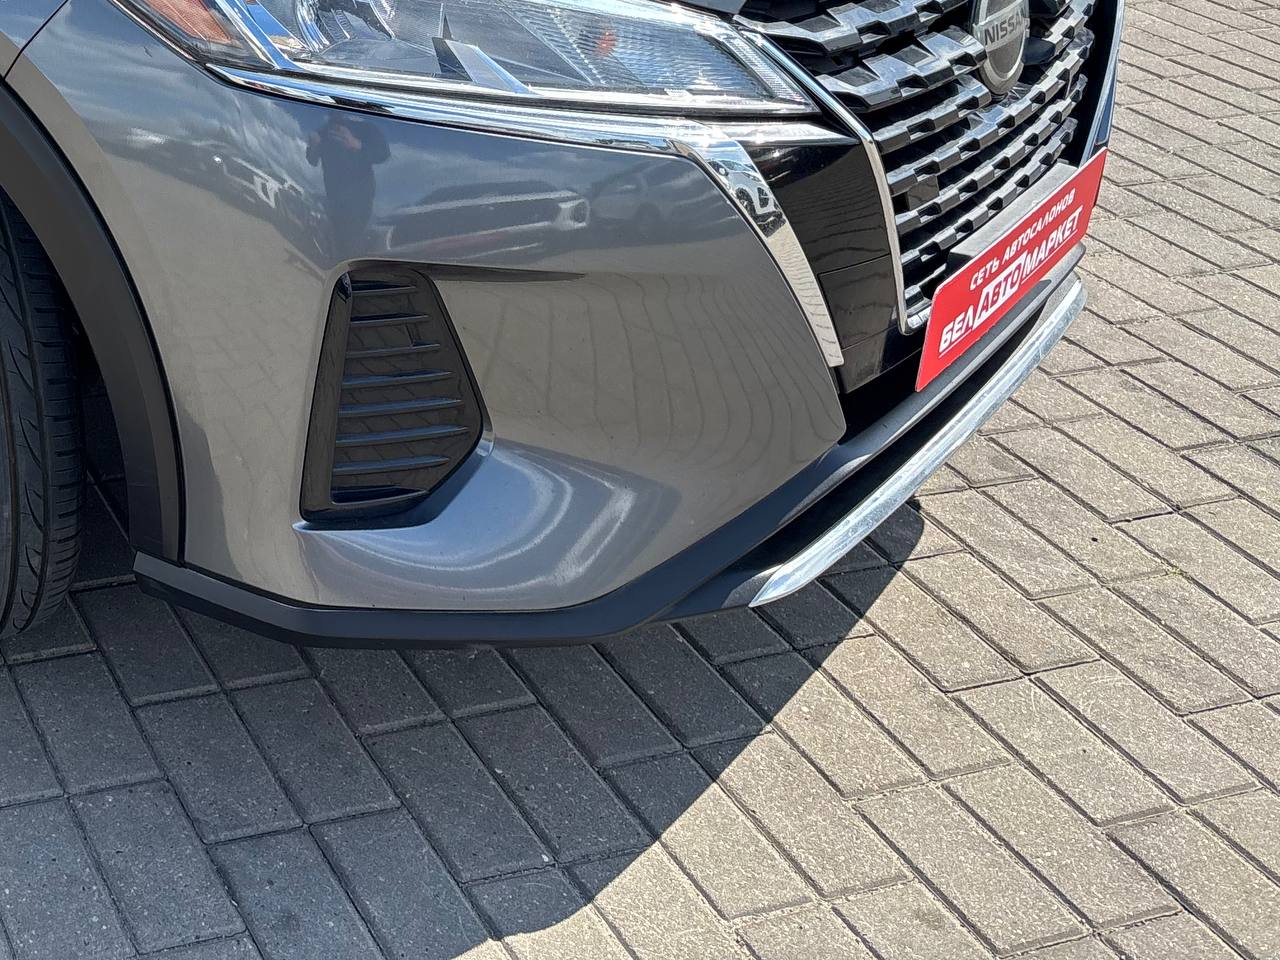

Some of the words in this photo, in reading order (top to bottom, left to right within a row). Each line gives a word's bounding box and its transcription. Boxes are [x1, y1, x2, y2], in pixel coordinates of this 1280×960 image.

[984, 6, 1026, 46] NISSAN
[970, 257, 1000, 291] СЕТЬ
[1001, 188, 1076, 265] АВТОСАЛОНОВ
